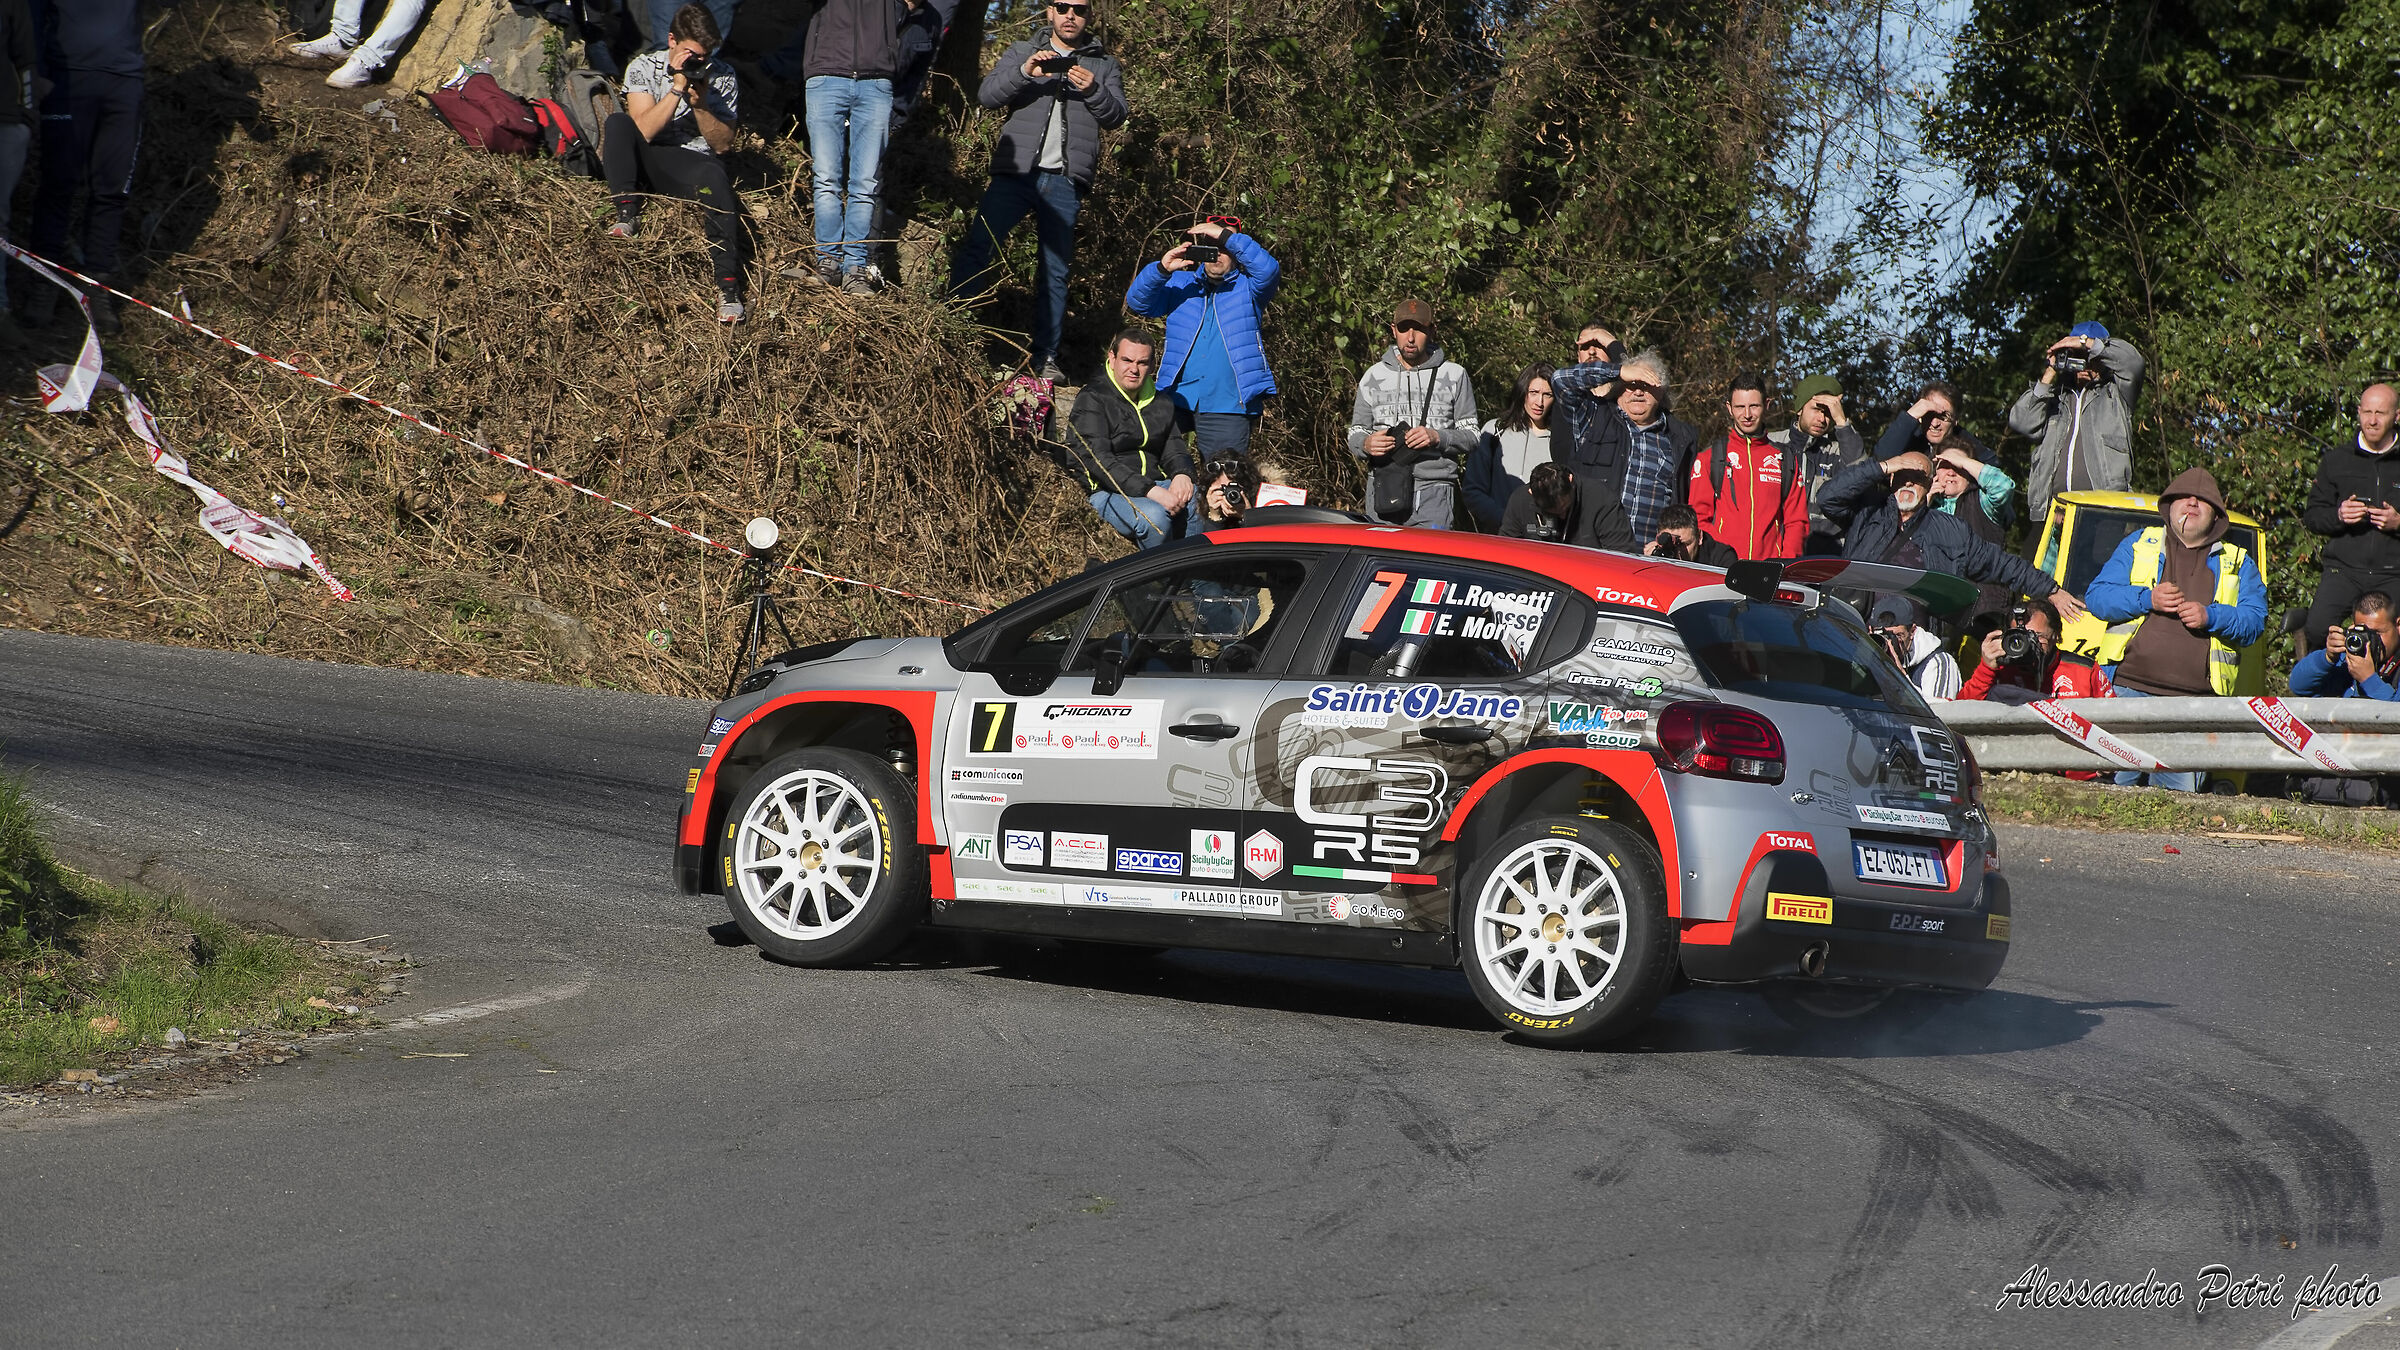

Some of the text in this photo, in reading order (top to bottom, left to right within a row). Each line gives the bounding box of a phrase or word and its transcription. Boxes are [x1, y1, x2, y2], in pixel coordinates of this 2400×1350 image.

[1358, 570, 1409, 634] 7
[1445, 582, 1556, 613] L.Rossetti
[1595, 586, 1659, 609] TOTAL
[1434, 613, 1512, 641] E. Mori
[1594, 638, 1676, 658] CAMAUTO
[1567, 672, 1659, 694] Greco Paolo
[1306, 684, 1521, 719] Saint Jane
[2050, 699, 2073, 718] ZONA
[1303, 714, 1341, 725] HOTELS
[1353, 717, 1388, 727] SUITES
[1558, 709, 1607, 732] wash
[1625, 710, 1649, 722] you
[2032, 699, 2085, 737] PERICOLOSA
[2250, 697, 2304, 749] PERICOLOSA
[2269, 701, 2293, 726] ZONA
[982, 703, 1008, 752] 7
[1028, 730, 1147, 746] Paoli Paoli Paoli
[1587, 732, 1640, 747] GROUP
[1910, 725, 1960, 771] C3
[962, 768, 1024, 780] comunicacon
[1293, 755, 1450, 832] C3
[957, 838, 992, 860] ANT
[1006, 834, 1043, 852] PSA
[1766, 832, 1813, 850] TOTAL
[1118, 852, 1181, 870] sparco
[1250, 847, 1278, 863] R-M
[1085, 887, 1109, 902] VTS
[1181, 891, 1236, 904] PALLADIO
[1240, 894, 1279, 907] GROUP
[1773, 897, 1828, 920] PIRELLI
[1921, 919, 1945, 932] sport
